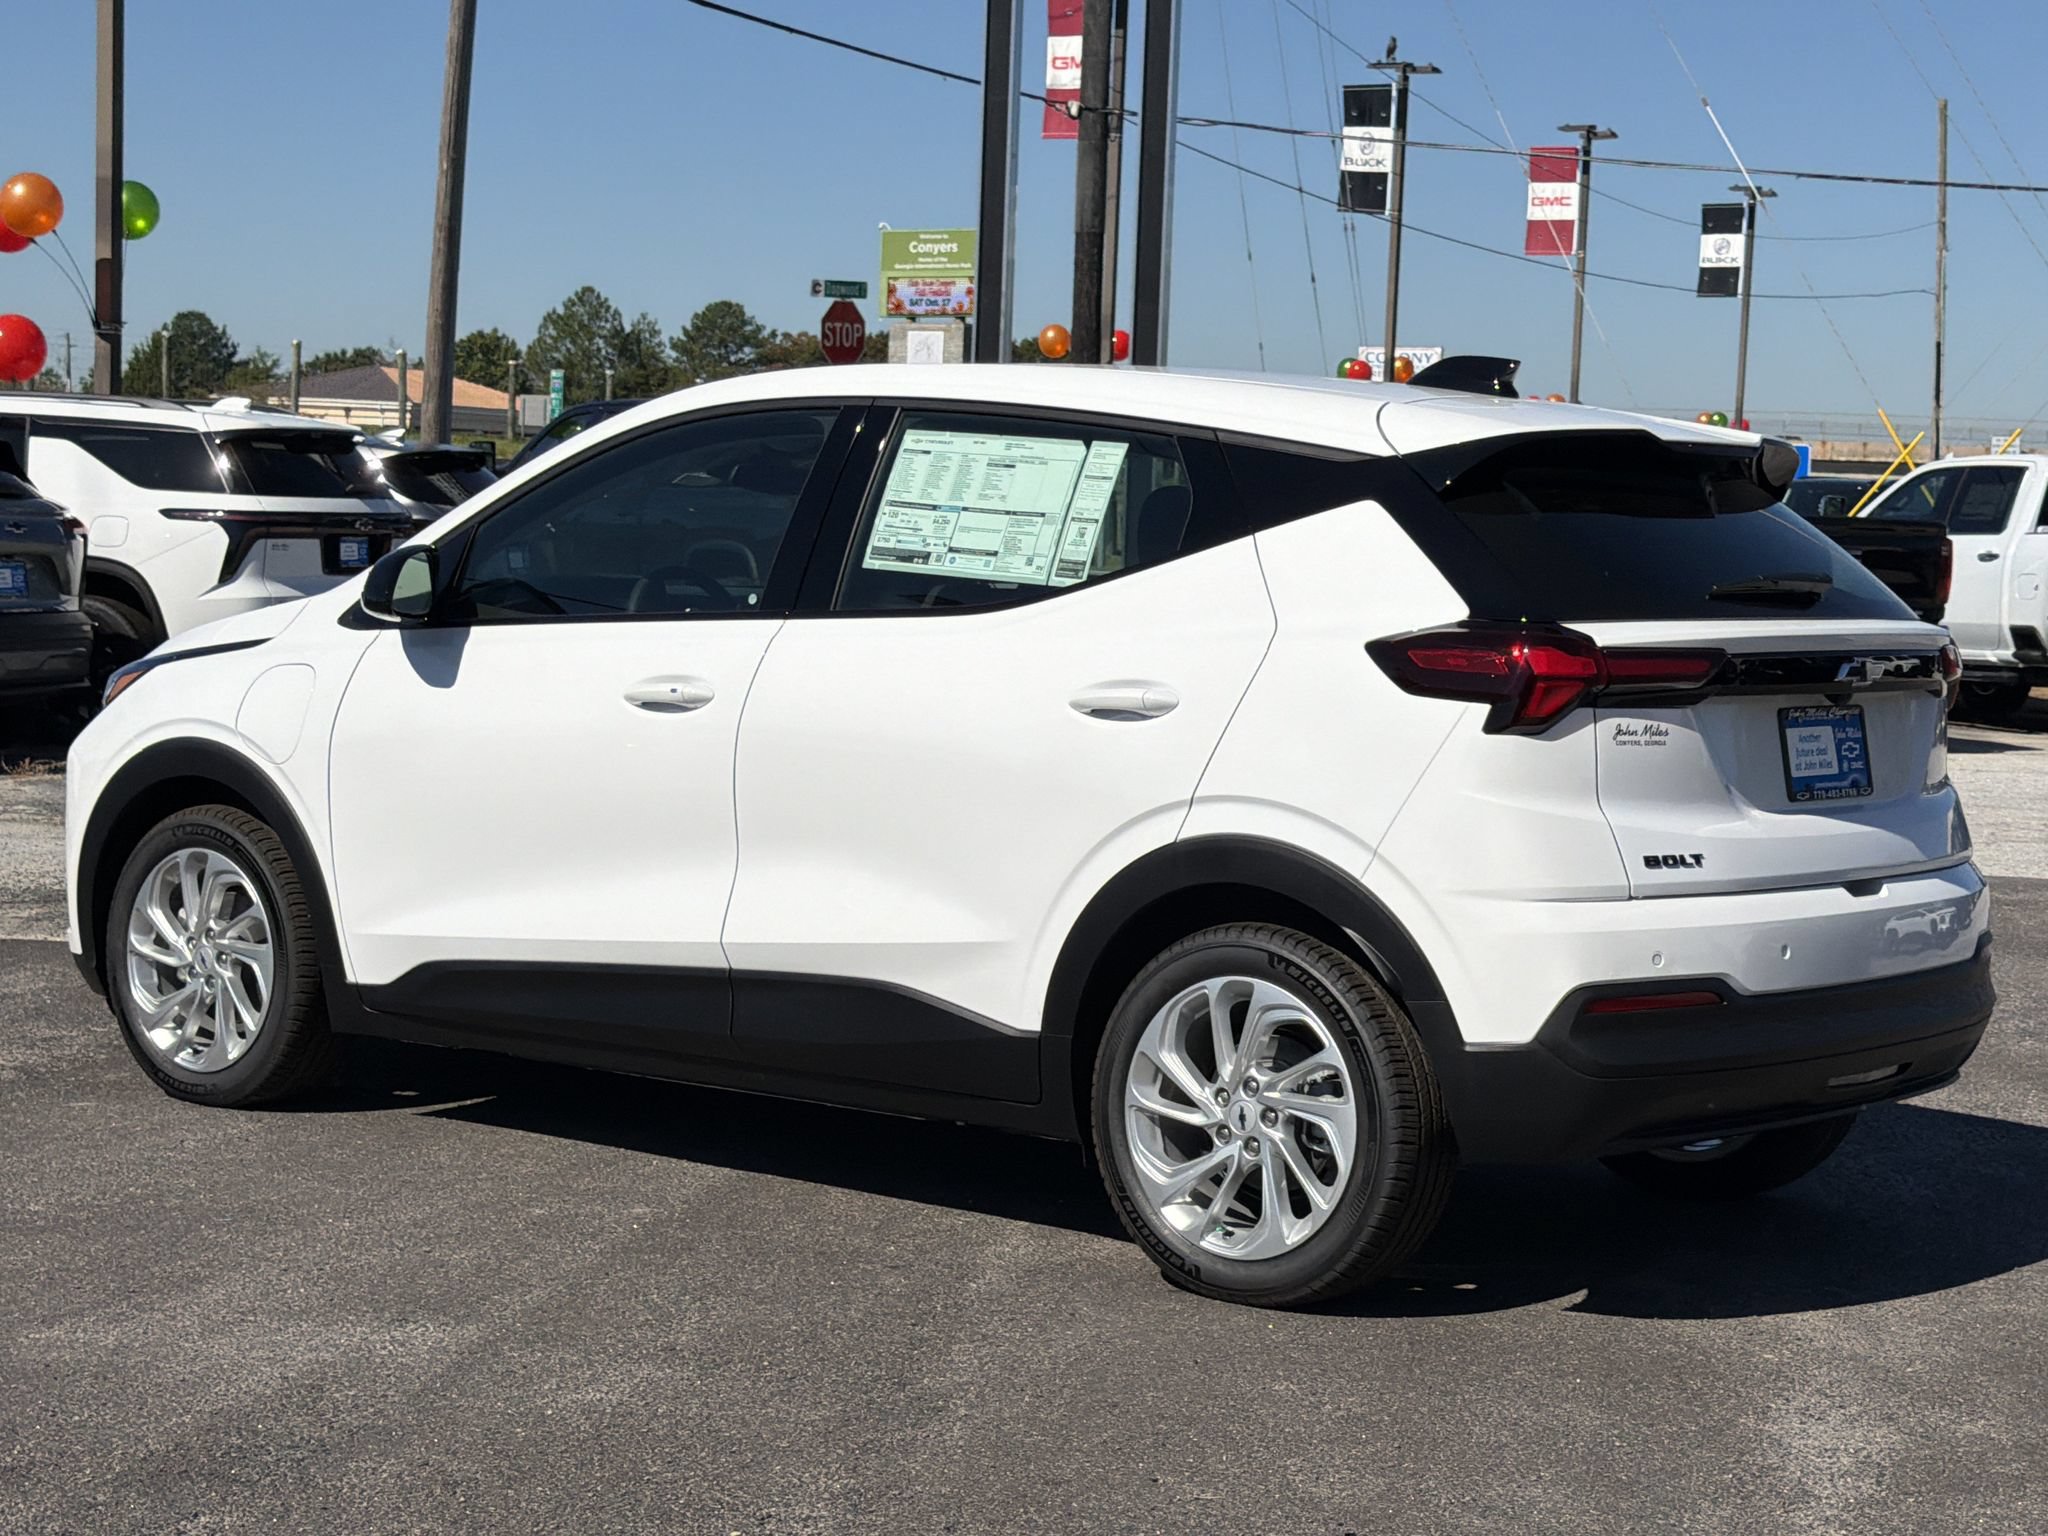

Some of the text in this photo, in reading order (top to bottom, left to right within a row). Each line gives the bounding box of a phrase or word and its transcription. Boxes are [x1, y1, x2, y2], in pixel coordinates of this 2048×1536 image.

[1051, 56, 1082, 70] GM
[1344, 157, 1387, 168] BUICK
[1531, 196, 1572, 207] GMC
[908, 241, 959, 255] Conyers
[1702, 256, 1739, 264] BUICK
[908, 298, 923, 307] SAT
[823, 322, 863, 347] STOP
[1613, 723, 1670, 741] John Miles
[1798, 733, 1822, 743] Another
[1795, 746, 1828, 760] future deal
[1804, 762, 1817, 771] John
[1818, 759, 1833, 769] Miles
[184, 825, 234, 847] MICHELIN
[1643, 853, 1706, 869] BOLT
[1286, 963, 1353, 1033] MICHELIN
[1123, 1200, 1185, 1267] MICHELIN
